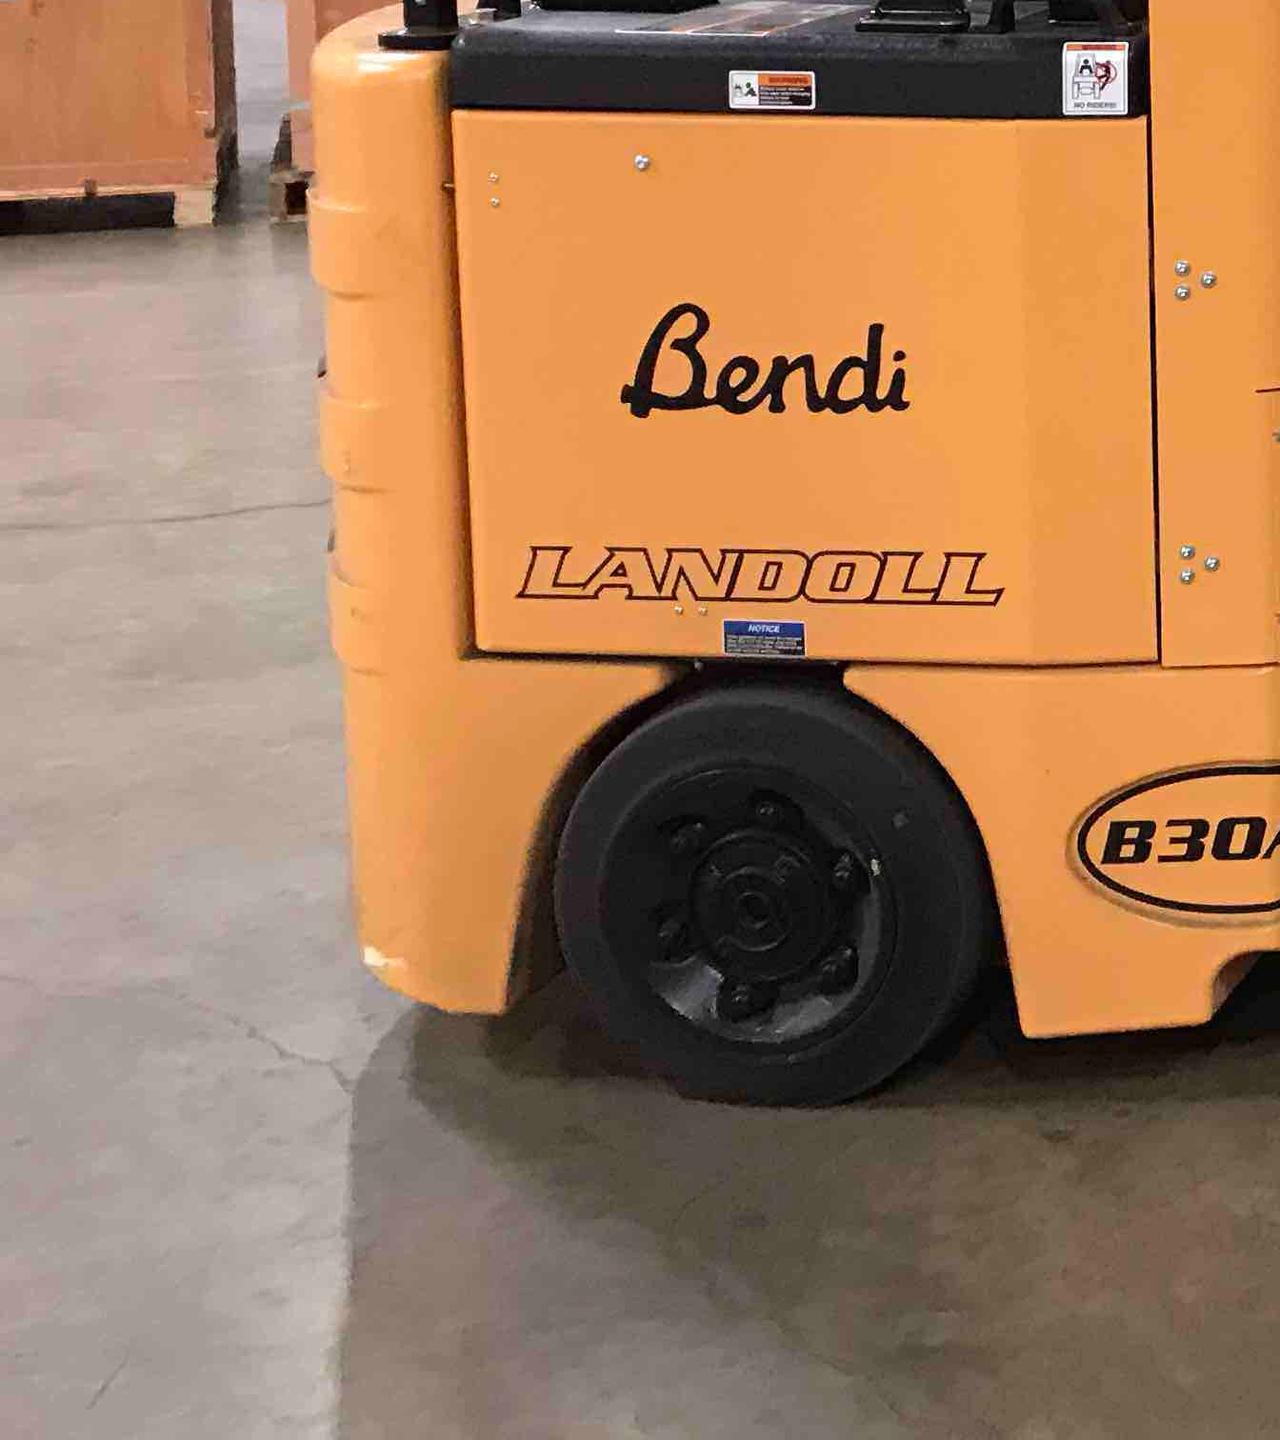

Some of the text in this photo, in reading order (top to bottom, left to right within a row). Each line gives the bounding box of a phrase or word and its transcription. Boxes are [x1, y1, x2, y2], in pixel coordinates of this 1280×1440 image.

[620, 302, 910, 418] Bendi
[515, 546, 1006, 607] LANDOLL
[747, 624, 781, 633] NOTICE
